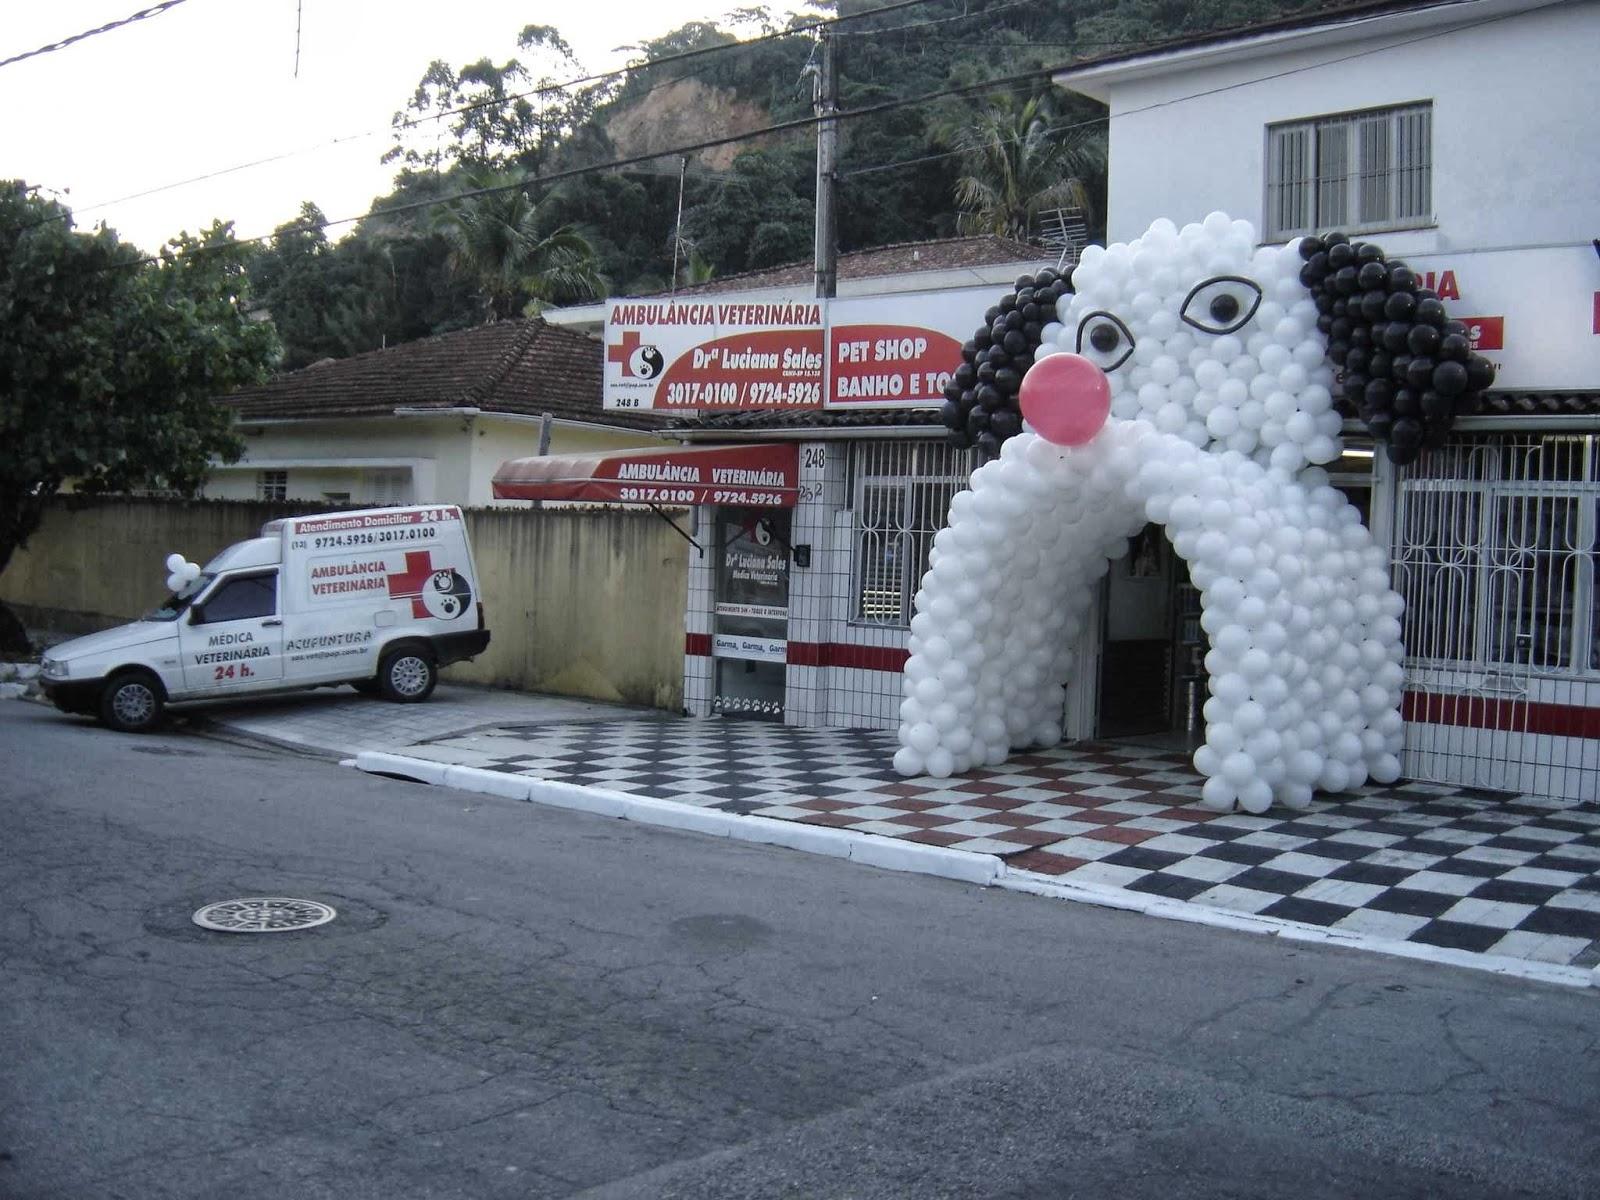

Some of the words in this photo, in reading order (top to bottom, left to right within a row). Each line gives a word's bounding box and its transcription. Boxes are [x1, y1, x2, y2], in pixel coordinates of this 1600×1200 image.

[610, 300, 714, 325] AMBULÂNCIA
[718, 300, 821, 325] VETERINÁRIA
[722, 347, 779, 369] Luciana
[782, 347, 822, 369] Sales
[838, 341, 870, 363] PET
[874, 338, 927, 362] SHOP
[667, 382, 738, 405] 3017-0100
[739, 382, 748, 406] /
[749, 382, 821, 404] 9724-5926
[837, 374, 904, 398] BANHO
[910, 373, 920, 395] E
[926, 371, 957, 394] TO
[616, 398, 631, 407] 248
[805, 448, 825, 468] 248
[617, 461, 700, 483] AMBULÂNCIA
[712, 467, 785, 487] VETERINÁRIA
[620, 487, 695, 502] 3017.0100
[701, 490, 708, 503] /
[713, 491, 782, 505] 9724.5926
[800, 482, 823, 502] 252
[299, 517, 362, 533] Atendimento
[365, 513, 413, 527] Domiciliar
[420, 510, 437, 523] 24
[311, 560, 386, 579] AMBULÂNCIA
[738, 553, 766, 569] Luciana
[766, 555, 787, 570] Sales
[312, 576, 386, 595] VETERINÁRIA
[208, 631, 254, 647] MÉDICA
[286, 630, 374, 651] ACUPUNTURA
[195, 646, 271, 665] VETERINÁRIA
[214, 665, 235, 680] 24
[240, 663, 255, 678] h.
